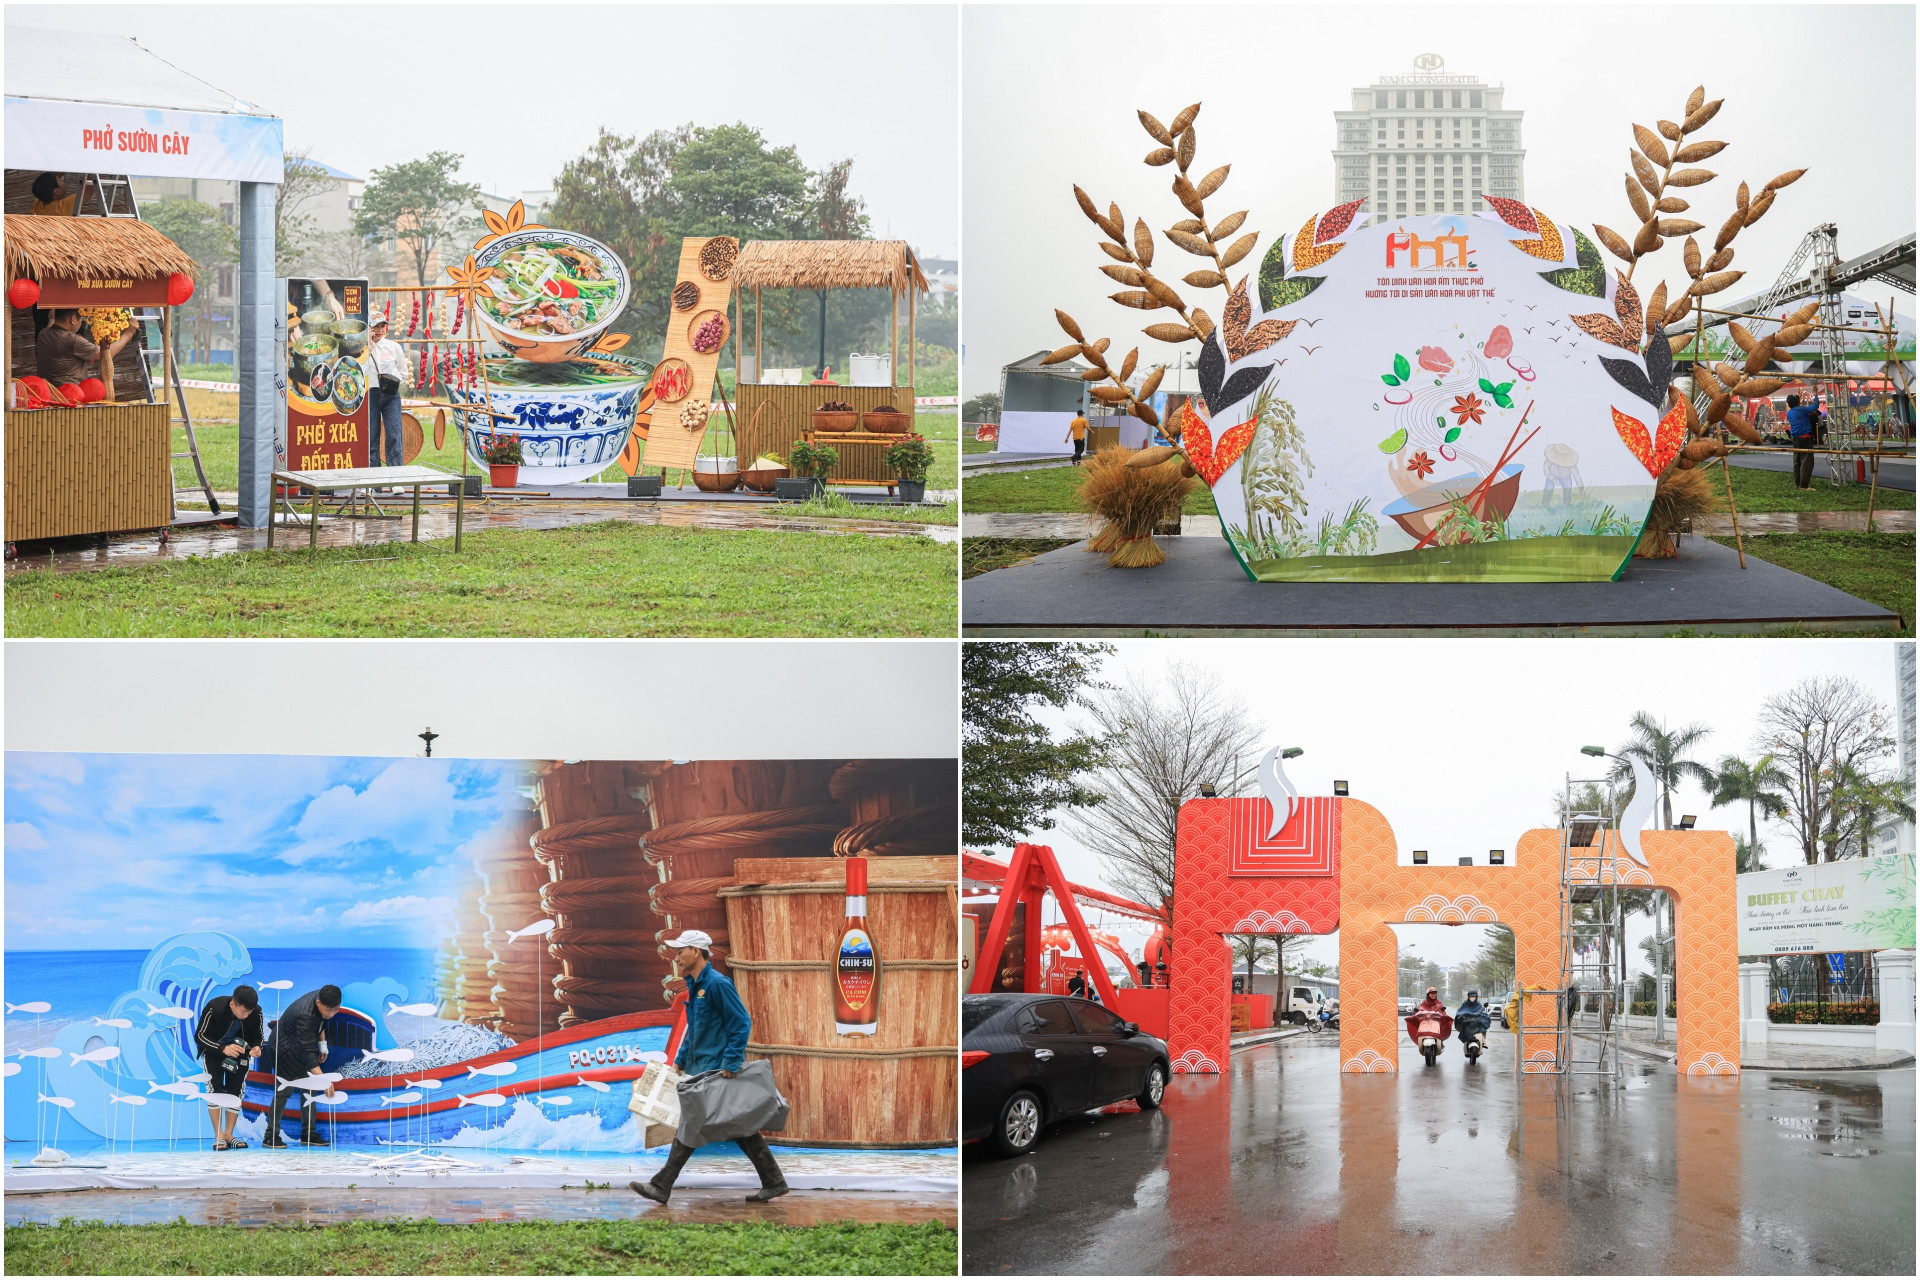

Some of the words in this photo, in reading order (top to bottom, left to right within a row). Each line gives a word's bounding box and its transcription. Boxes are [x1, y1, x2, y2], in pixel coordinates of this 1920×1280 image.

[1445, 76, 1479, 84] HOTEL
[83, 124, 113, 150] PHỞ
[118, 128, 158, 153] SƯỜN
[162, 131, 190, 155] CÂY
[1470, 275, 1484, 286] PHỞ
[1455, 289, 1466, 298] PHI
[297, 418, 326, 446] PHỞ
[329, 420, 358, 443] XƯA
[301, 447, 330, 471] ĐỐT
[334, 447, 354, 470] ĐÁ
[1747, 890, 1798, 907] BUFFET
[1802, 885, 1846, 901] CHAY
[840, 958, 873, 967] CHIN-SU
